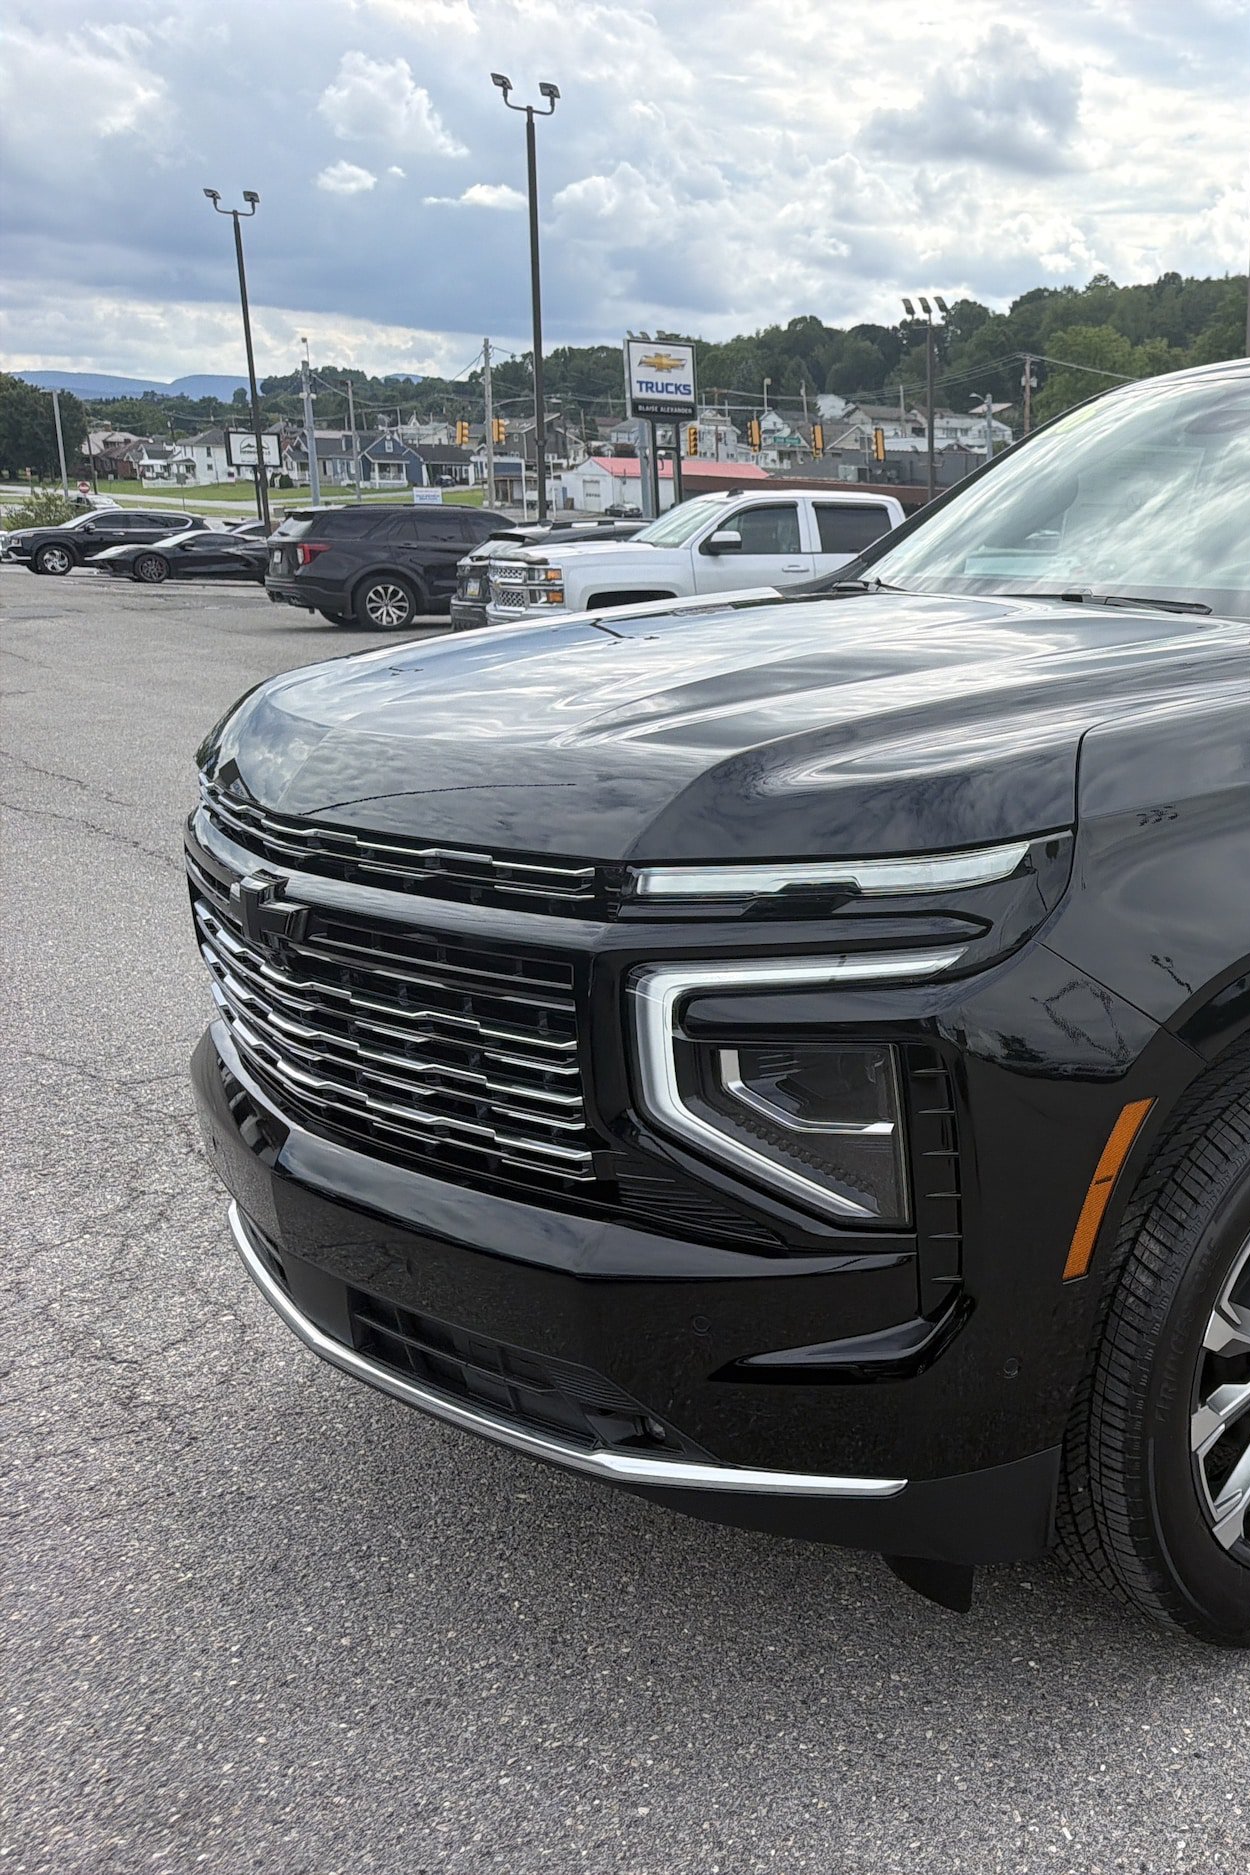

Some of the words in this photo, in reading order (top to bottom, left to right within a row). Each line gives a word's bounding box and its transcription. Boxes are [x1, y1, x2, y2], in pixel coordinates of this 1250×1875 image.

[636, 380, 692, 396] TRUCKS
[638, 404, 659, 412] BLAISE
[660, 405, 693, 414] ALEXANDER
